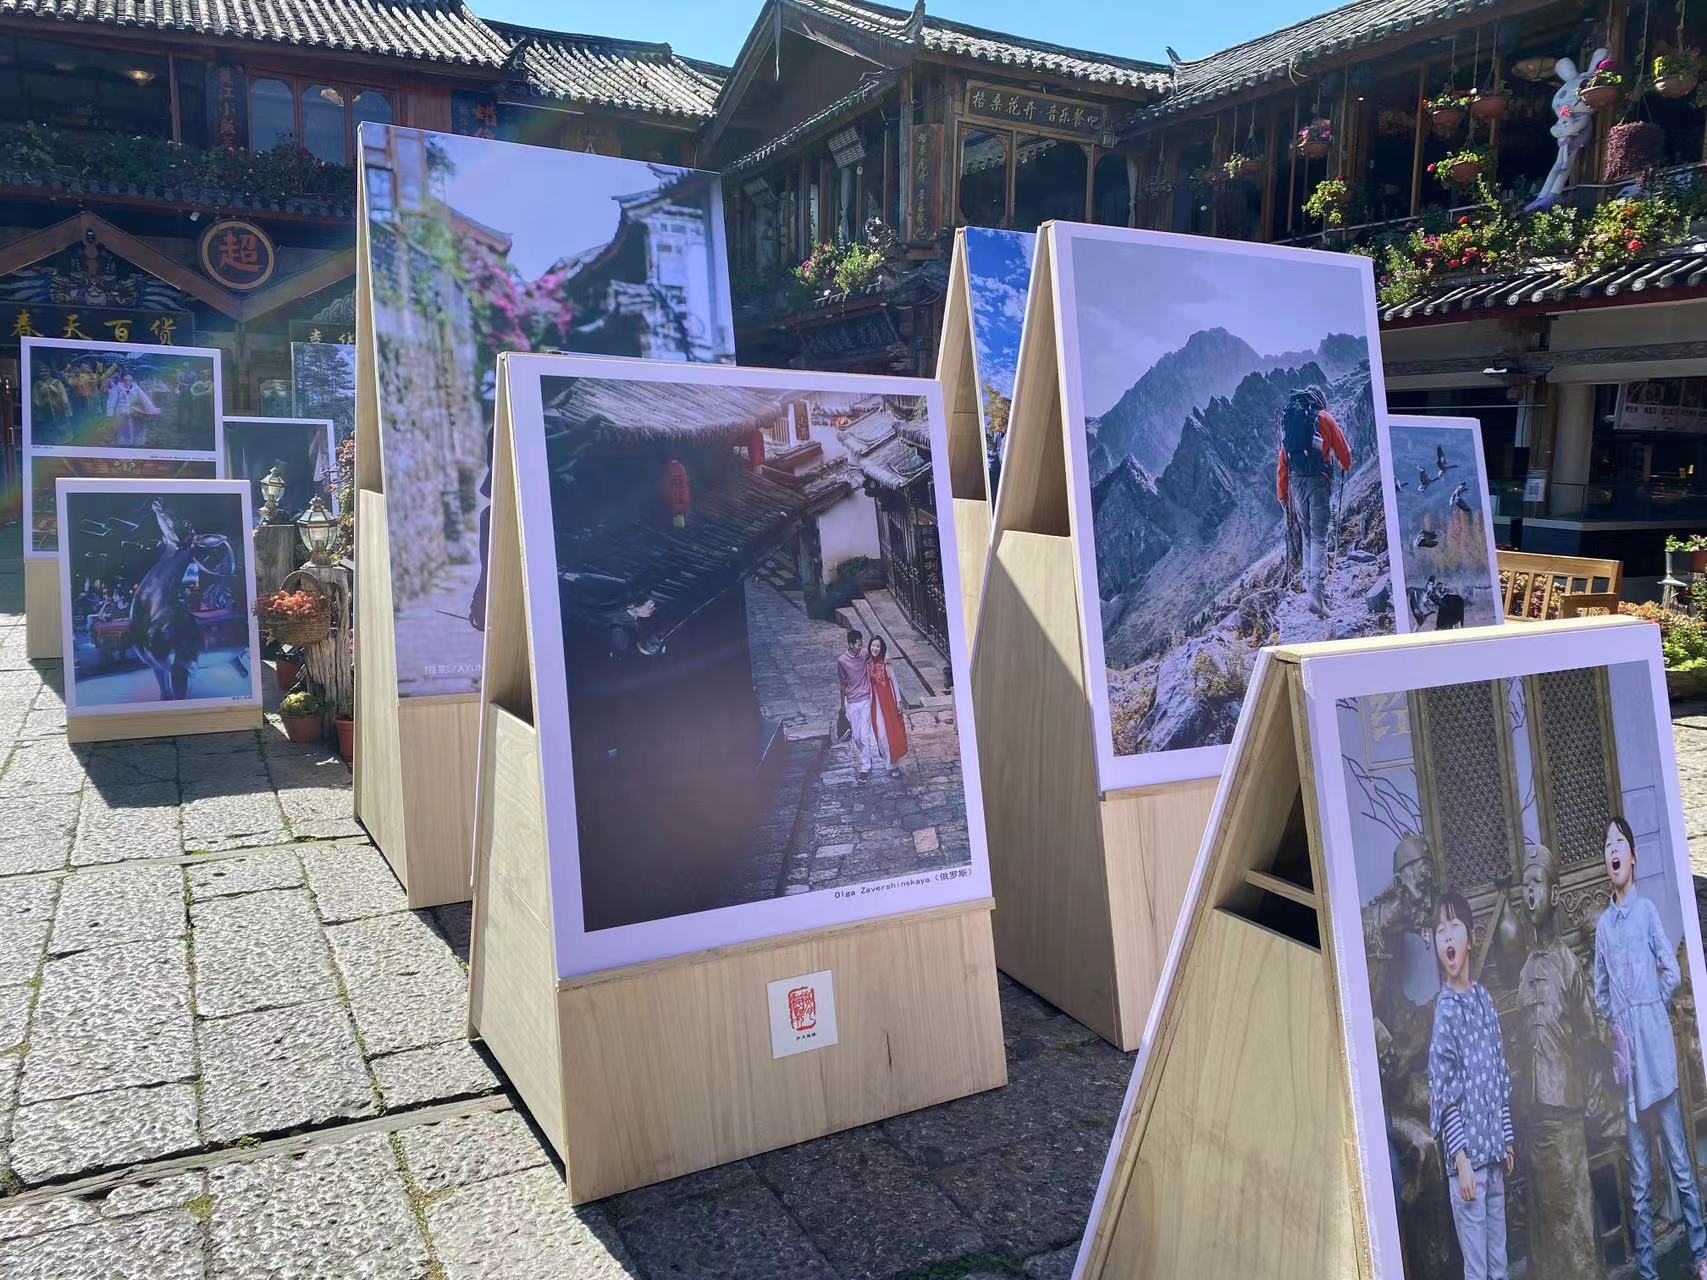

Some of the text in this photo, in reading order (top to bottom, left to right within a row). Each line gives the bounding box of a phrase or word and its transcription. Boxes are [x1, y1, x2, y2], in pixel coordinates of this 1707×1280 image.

[217, 230, 260, 272] 超
[9, 308, 178, 346] 春天百货
[834, 890, 856, 899] Olga
[860, 877, 930, 893] Zavershinskaya
